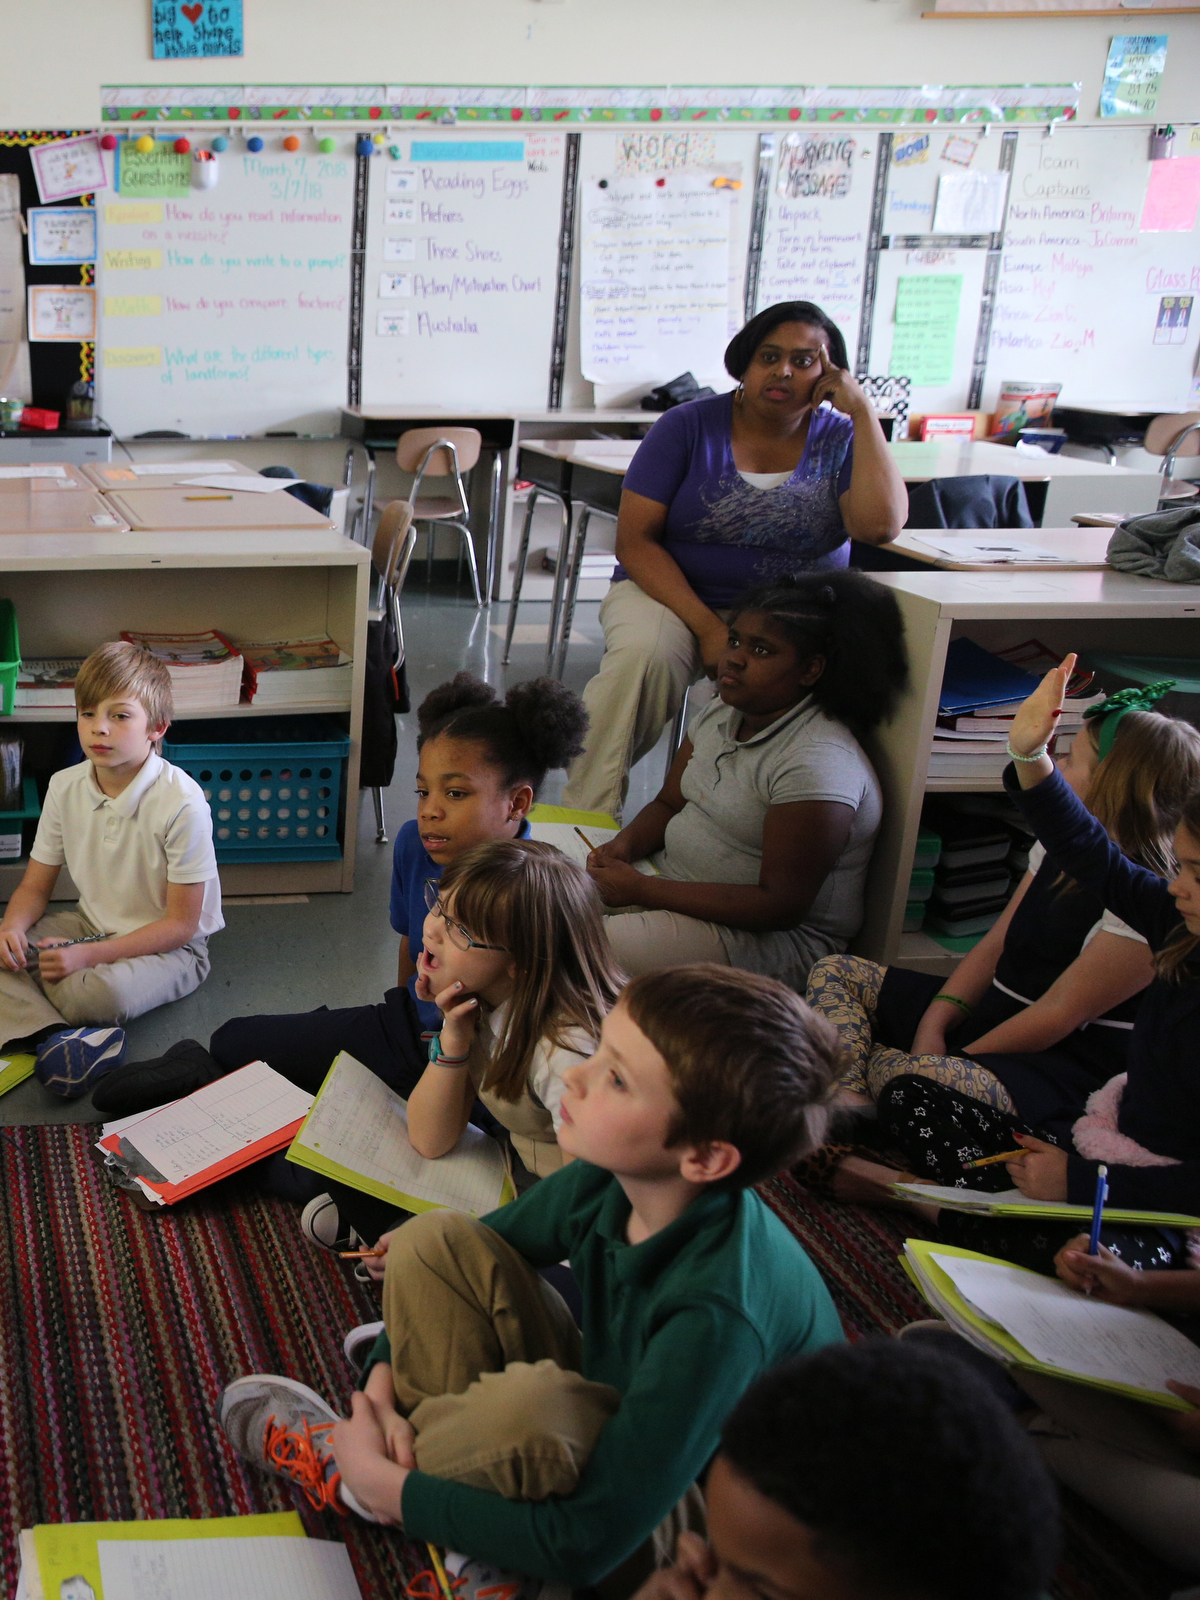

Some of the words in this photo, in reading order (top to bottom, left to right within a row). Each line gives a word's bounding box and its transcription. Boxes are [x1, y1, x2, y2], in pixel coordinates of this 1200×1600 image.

[780, 137, 856, 170] MORNING
[1027, 142, 1079, 171] Team
[317, 160, 347, 178] 2018
[268, 178, 323, 201] 3/7/18
[421, 166, 486, 199] Reading
[492, 166, 530, 199] Eggs
[785, 169, 851, 200] MESSAGE
[1022, 173, 1091, 198] Captains
[165, 204, 193, 222] How
[199, 205, 215, 221] do
[220, 211, 243, 227] you
[778, 207, 822, 230] Unpack
[1009, 203, 1041, 220] North
[777, 228, 799, 243] Turn
[817, 230, 863, 244] homework
[1004, 230, 1036, 248] South
[419, 236, 459, 261] Those
[465, 239, 502, 262] Shoes
[790, 245, 807, 257] any
[167, 251, 194, 266] How
[200, 251, 215, 266] do
[219, 255, 242, 274] you
[280, 251, 291, 267] to
[777, 257, 796, 270] Take
[800, 259, 816, 270] out
[512, 274, 542, 293] Chart
[1145, 266, 1188, 292] Class
[166, 296, 191, 312] How
[196, 297, 211, 310] do
[213, 300, 235, 318] you
[417, 311, 480, 338] Australia
[164, 346, 199, 366] What
[161, 368, 174, 385] of
